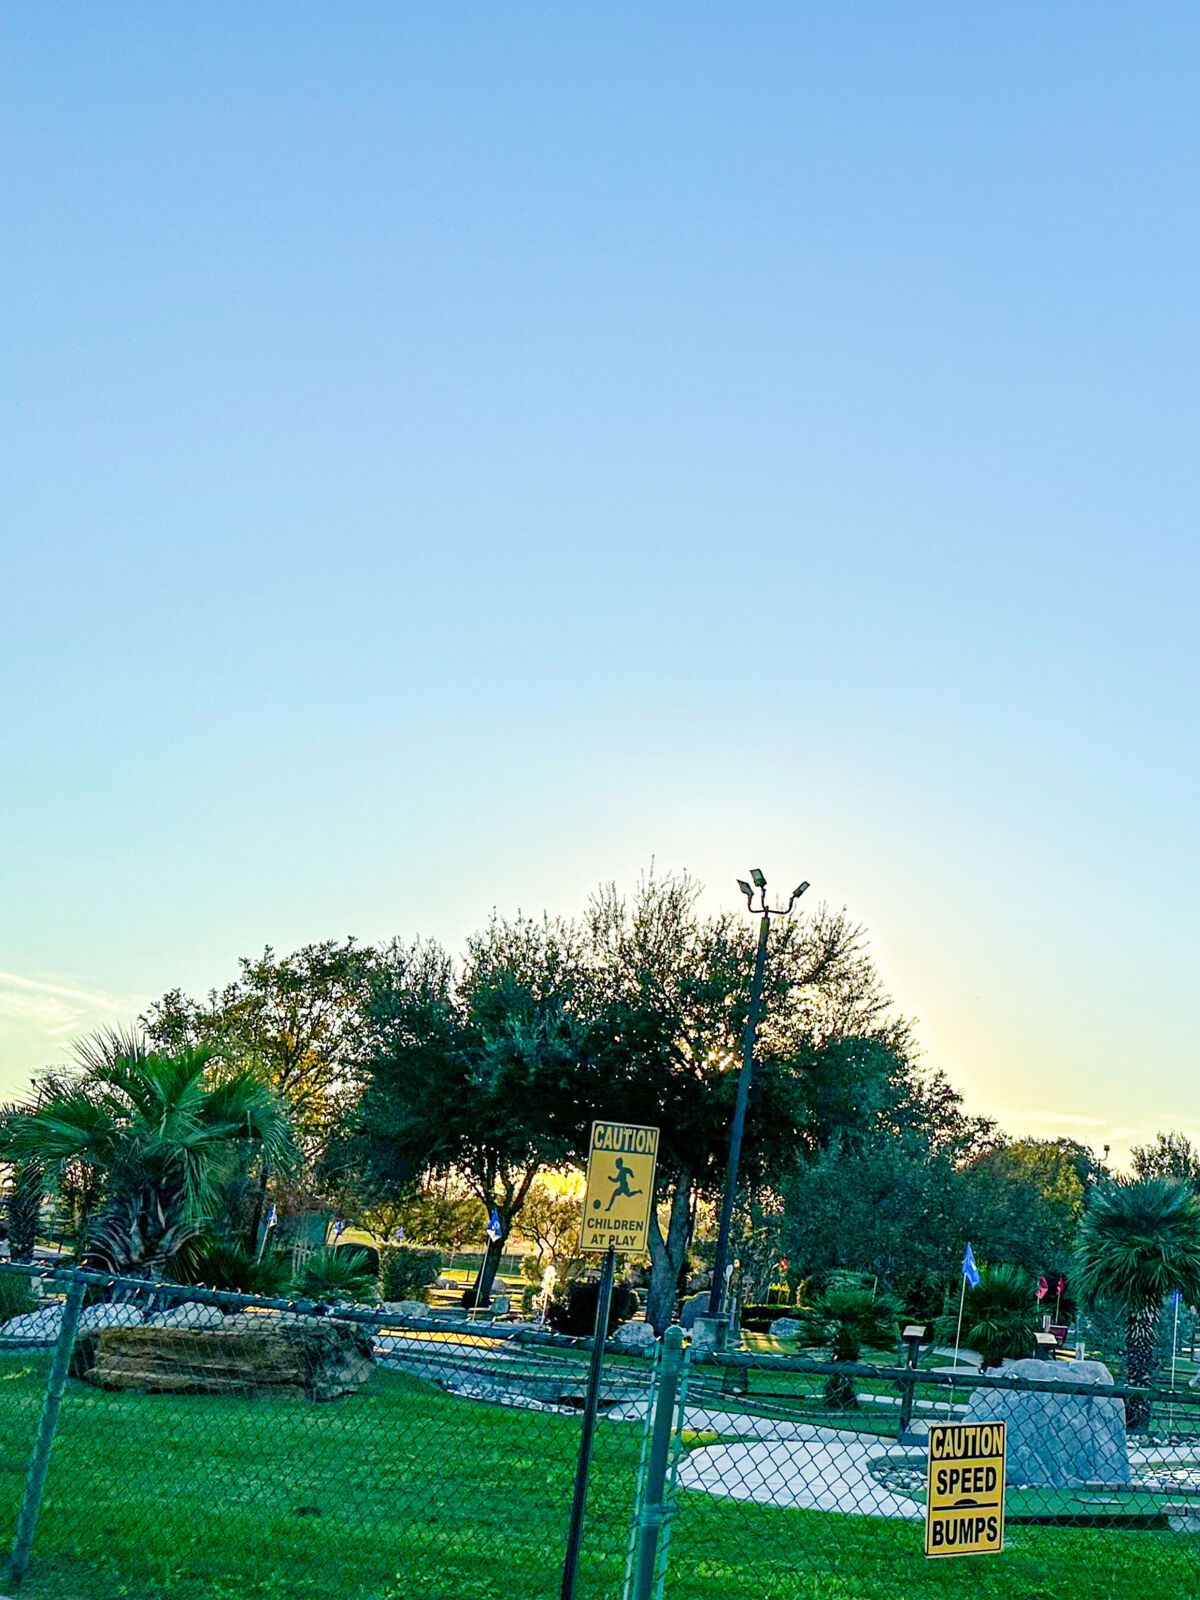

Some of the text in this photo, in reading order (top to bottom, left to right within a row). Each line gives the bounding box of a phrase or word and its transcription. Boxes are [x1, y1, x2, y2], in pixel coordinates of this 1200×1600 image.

[594, 1125, 656, 1153] CAUTION
[587, 1217, 644, 1231] CHILDREN
[590, 1233, 637, 1246] AT PLAY
[932, 1426, 1004, 1459] CAUTION
[936, 1466, 997, 1496] SPEED
[932, 1516, 998, 1547] BUMPS
